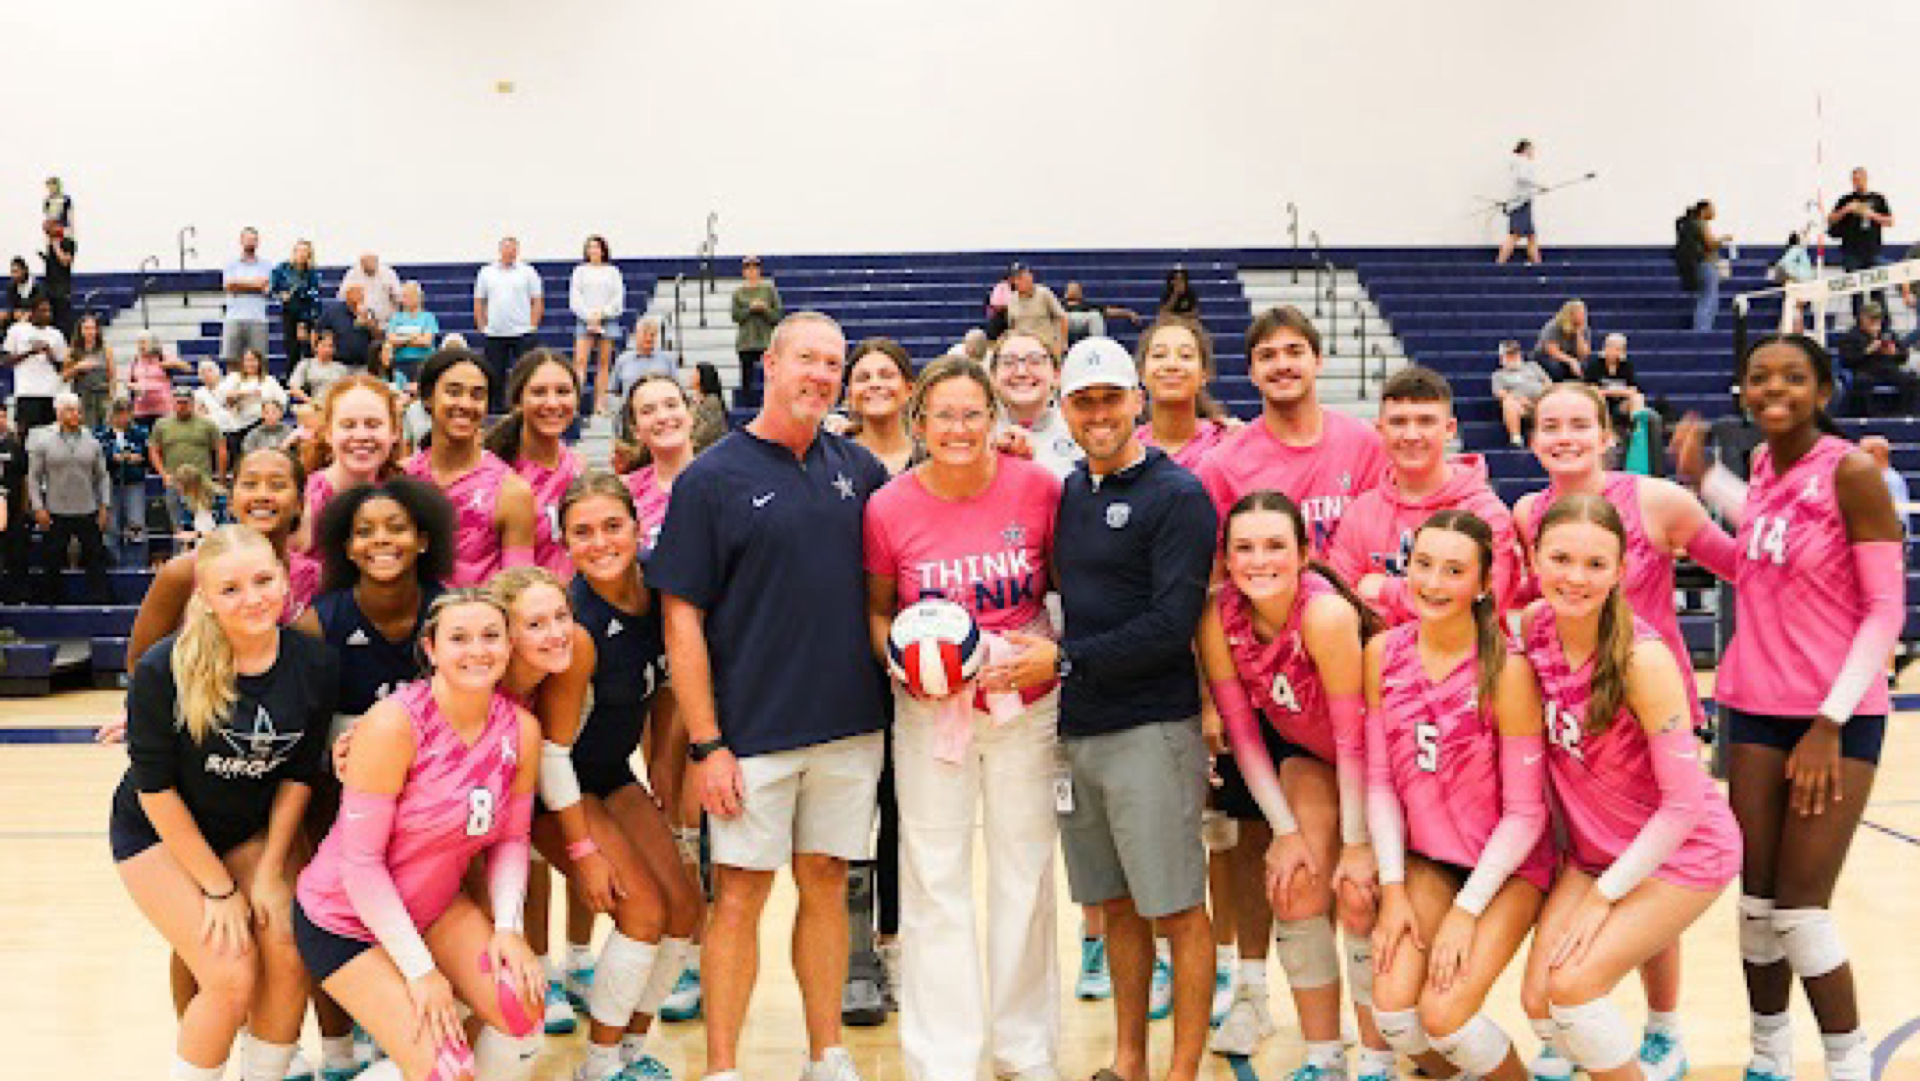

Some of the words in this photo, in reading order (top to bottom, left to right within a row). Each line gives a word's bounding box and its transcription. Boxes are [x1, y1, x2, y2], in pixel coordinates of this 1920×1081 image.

[1747, 516, 1789, 566] 14
[916, 548, 1033, 588] THINK
[1273, 673, 1301, 714] 4
[1415, 722, 1439, 772] 5
[467, 786, 495, 836] 8
